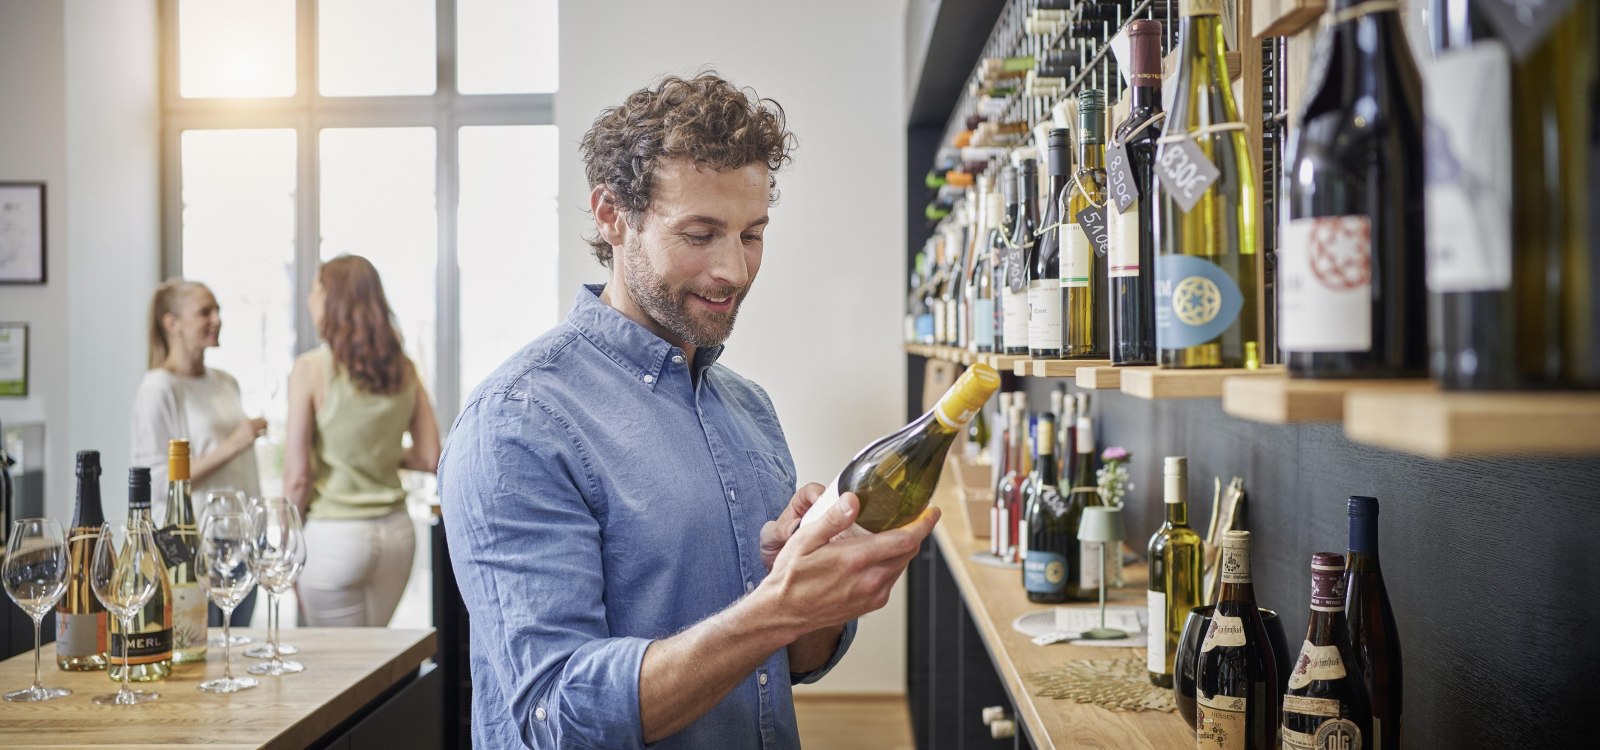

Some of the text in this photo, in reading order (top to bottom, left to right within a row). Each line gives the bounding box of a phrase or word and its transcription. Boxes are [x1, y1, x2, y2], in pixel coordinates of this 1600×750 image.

[1110, 155, 1131, 207] 8,90€
[1160, 144, 1208, 199] 8,30€
[1083, 211, 1109, 254] 5,10€
[1211, 711, 1237, 721] HESSEN
